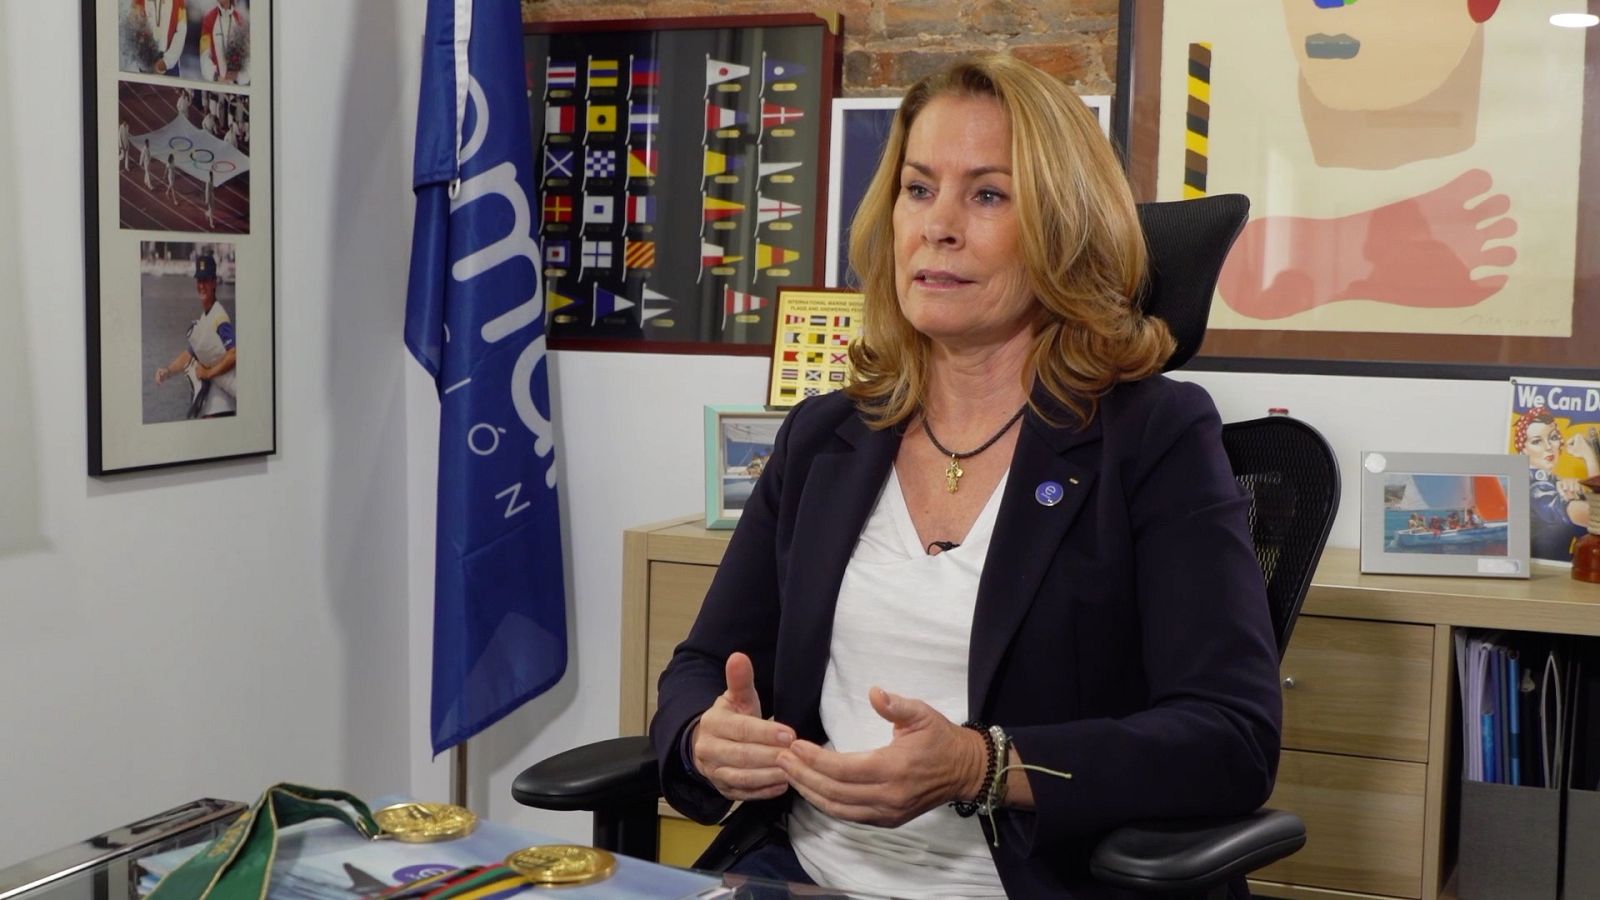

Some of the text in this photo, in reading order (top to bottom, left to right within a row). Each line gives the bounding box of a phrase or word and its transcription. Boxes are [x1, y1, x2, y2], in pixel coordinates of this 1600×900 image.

[1517, 385, 1600, 412] We Can D
